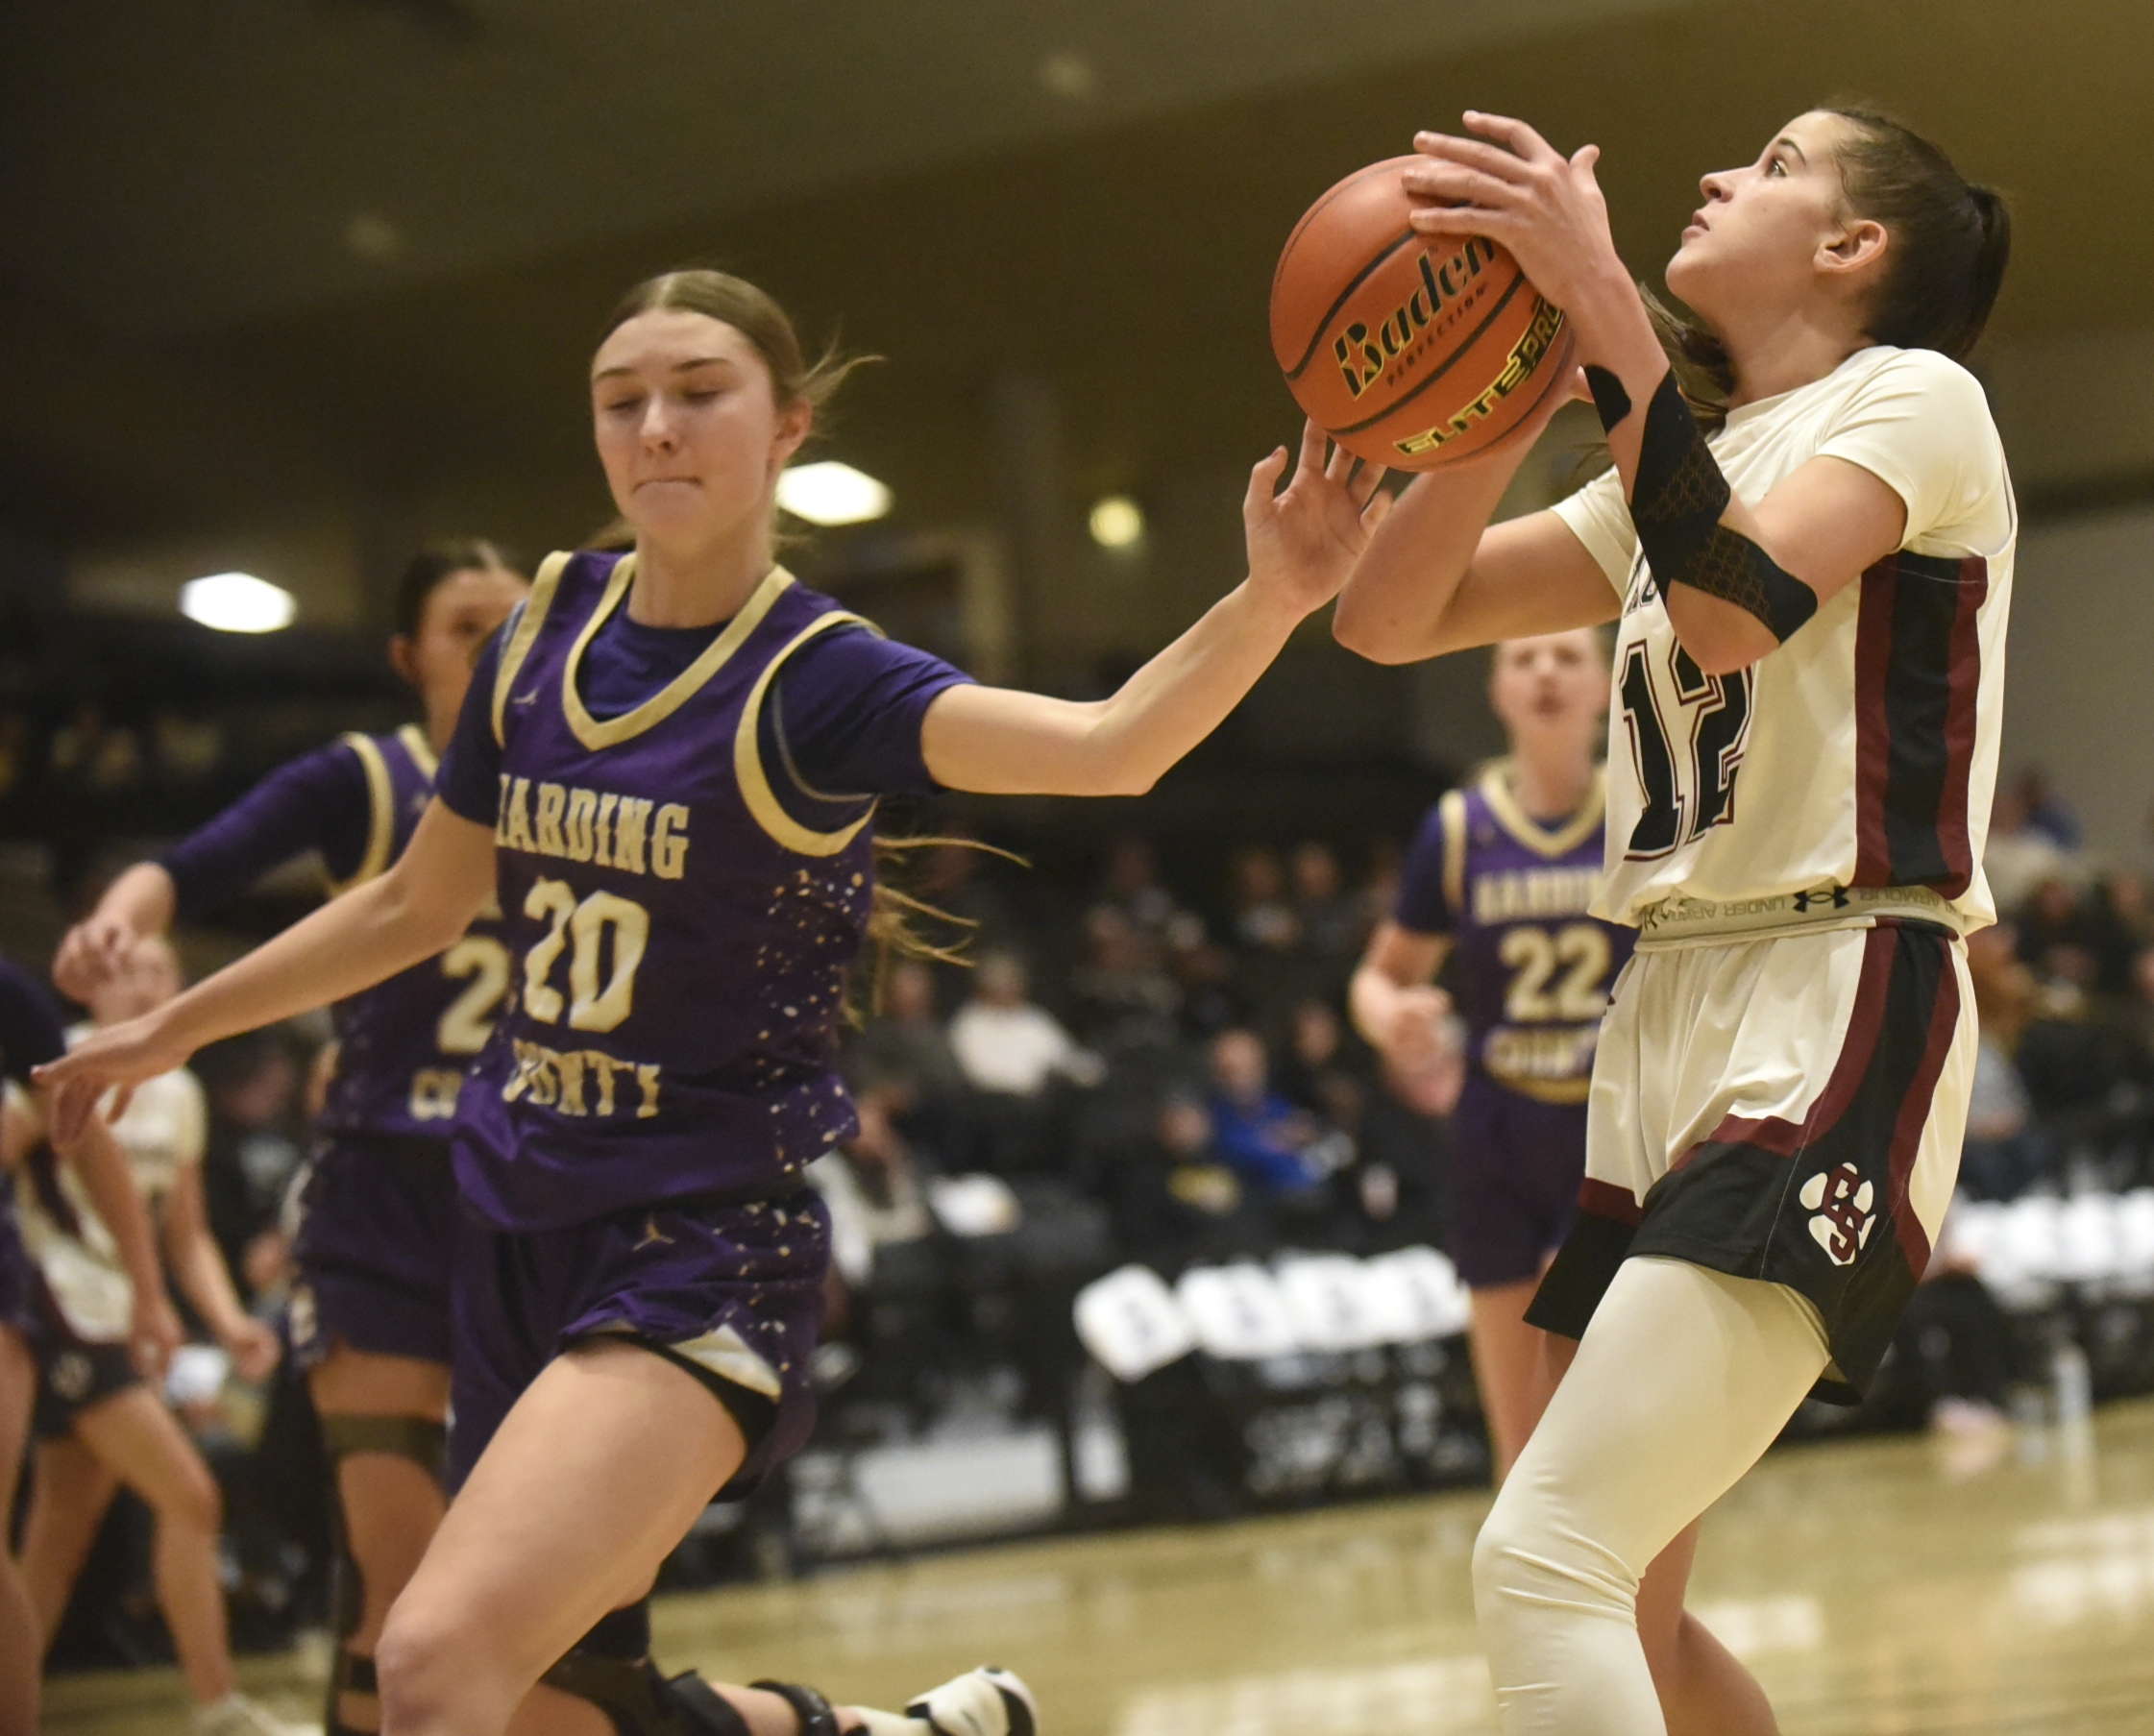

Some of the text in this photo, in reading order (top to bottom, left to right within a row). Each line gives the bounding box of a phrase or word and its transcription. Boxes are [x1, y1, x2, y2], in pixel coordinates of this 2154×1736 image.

[1334, 236, 1495, 400] Baden
[1393, 355, 1530, 456] ELITE
[1620, 634, 1754, 862] 12
[523, 875, 649, 1033] 20
[1724, 896, 1785, 917] UNDER
[1498, 923, 1612, 1022] 22
